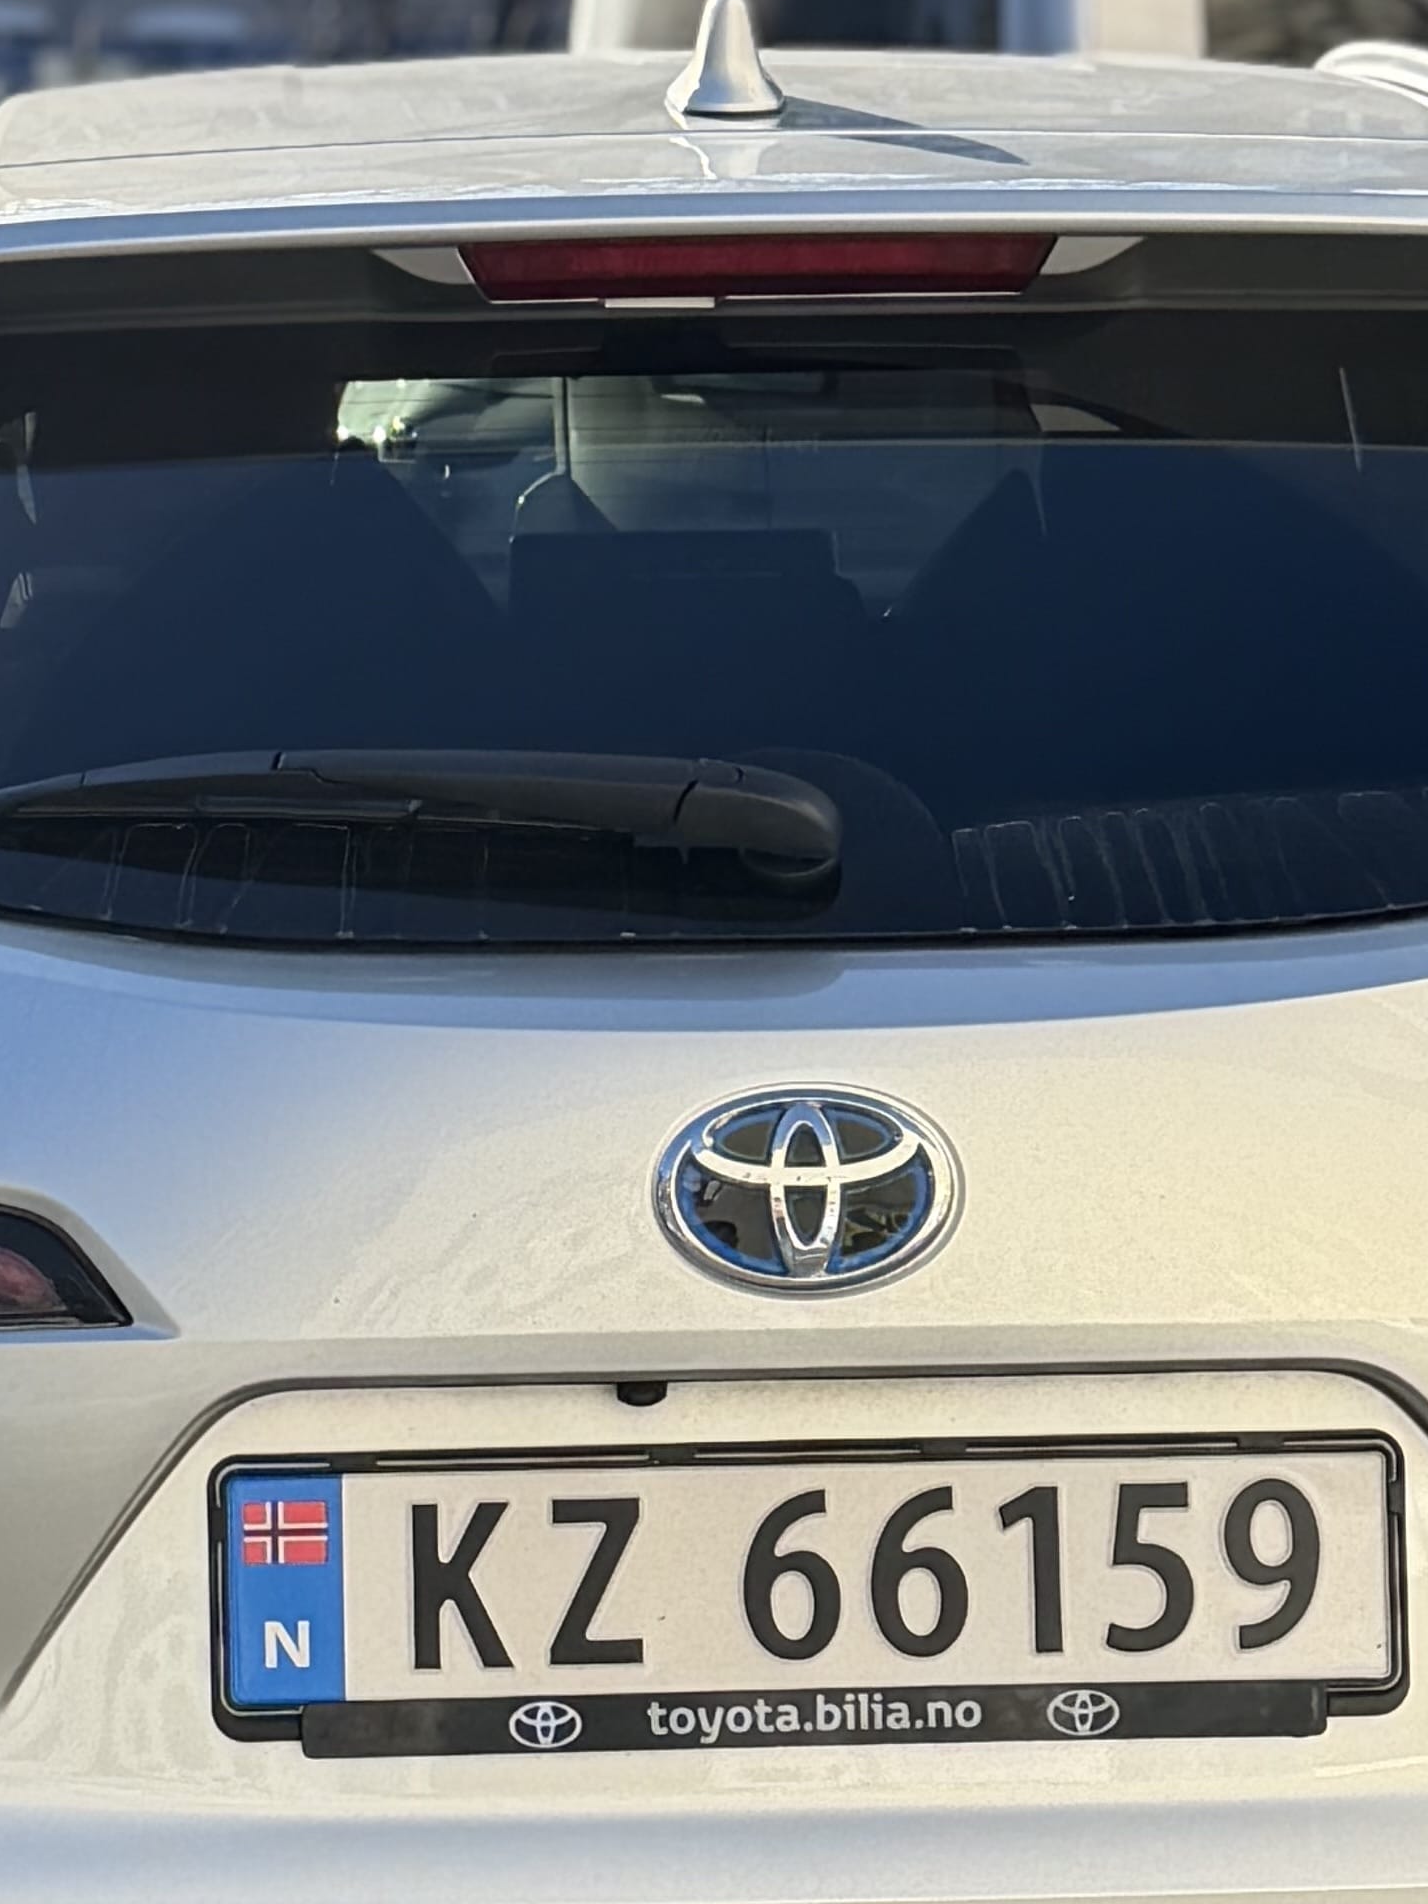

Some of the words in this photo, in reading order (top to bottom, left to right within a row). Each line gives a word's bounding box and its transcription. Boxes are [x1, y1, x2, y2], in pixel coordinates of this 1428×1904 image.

[410, 1497, 645, 1672] KZ
[741, 1478, 1322, 1662] 66159
[264, 1617, 311, 1669] N
[646, 1693, 983, 1740] toyota.bilia.no
